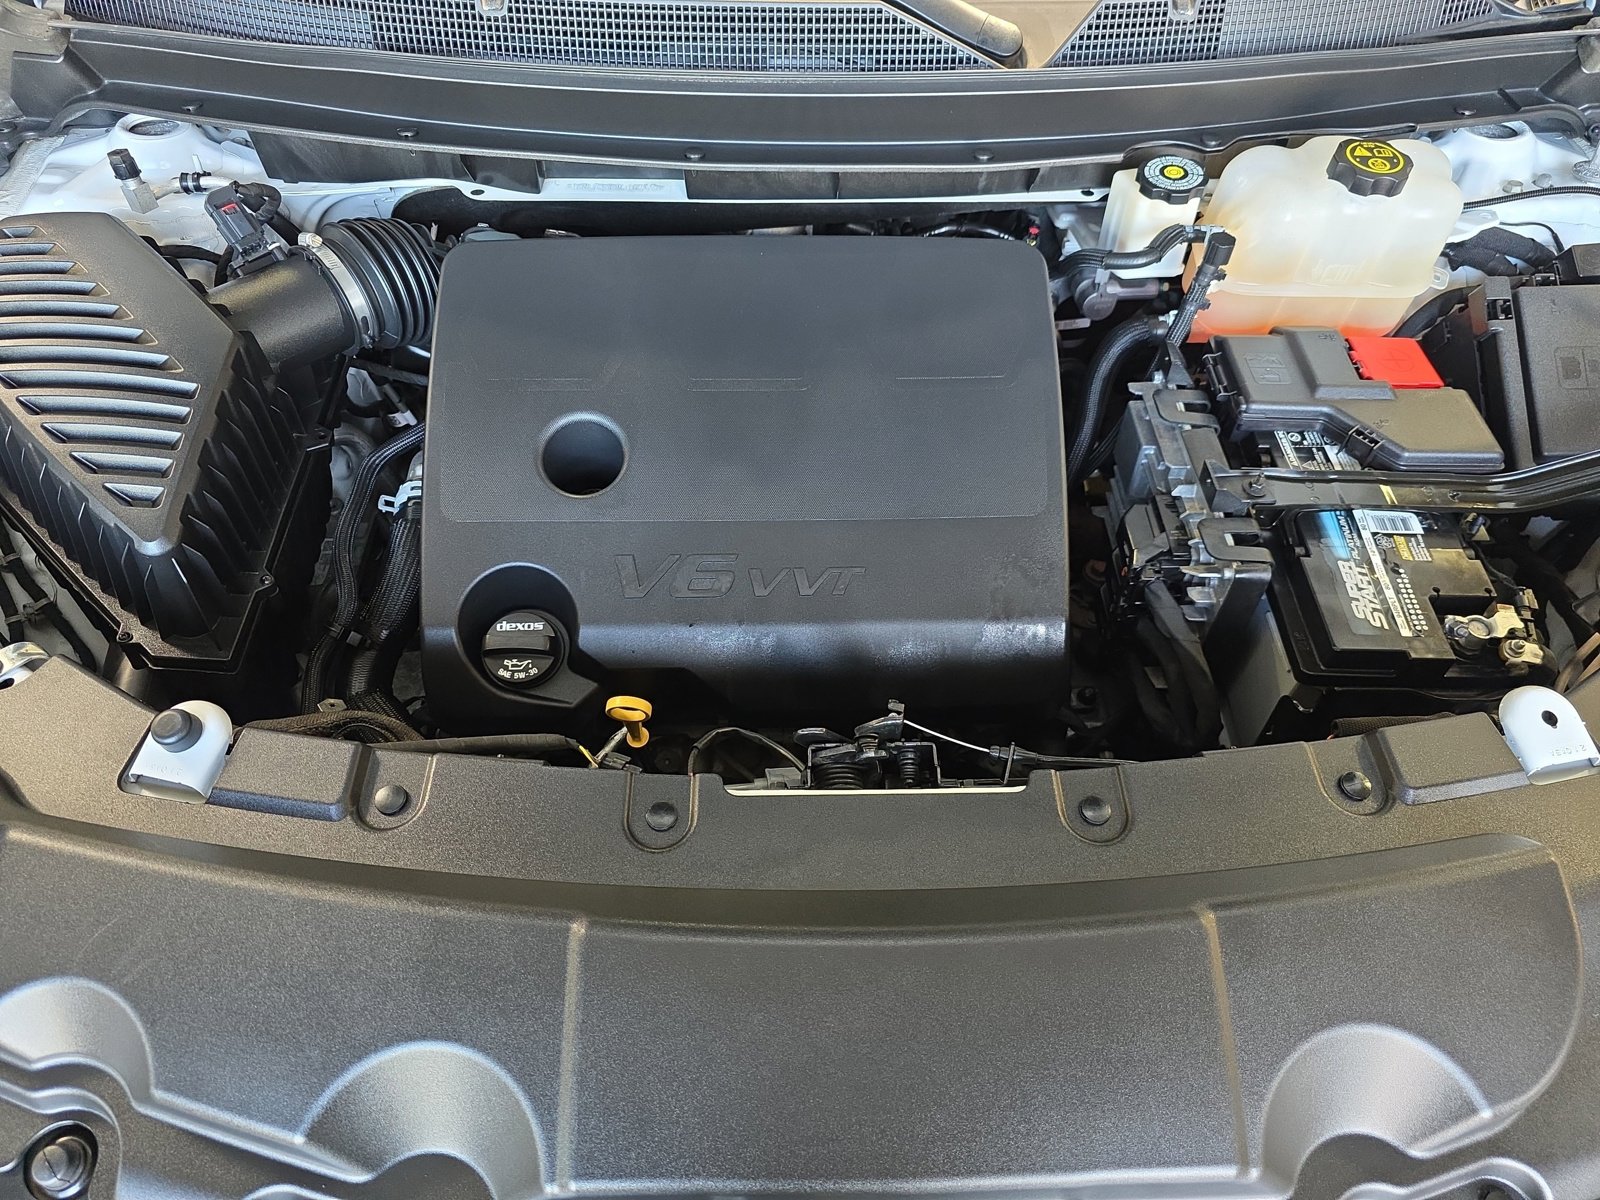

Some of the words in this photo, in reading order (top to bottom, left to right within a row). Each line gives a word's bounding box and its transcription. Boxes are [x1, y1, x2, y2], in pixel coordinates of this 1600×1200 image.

[1338, 515, 1360, 560] PLATINUM
[613, 553, 739, 599] V6
[748, 566, 866, 597] VVT
[1337, 560, 1365, 619] SUPER
[1357, 562, 1389, 630] START
[496, 621, 545, 631] dexos
[497, 668, 512, 679] SAE
[513, 667, 538, 679] 5W-30
